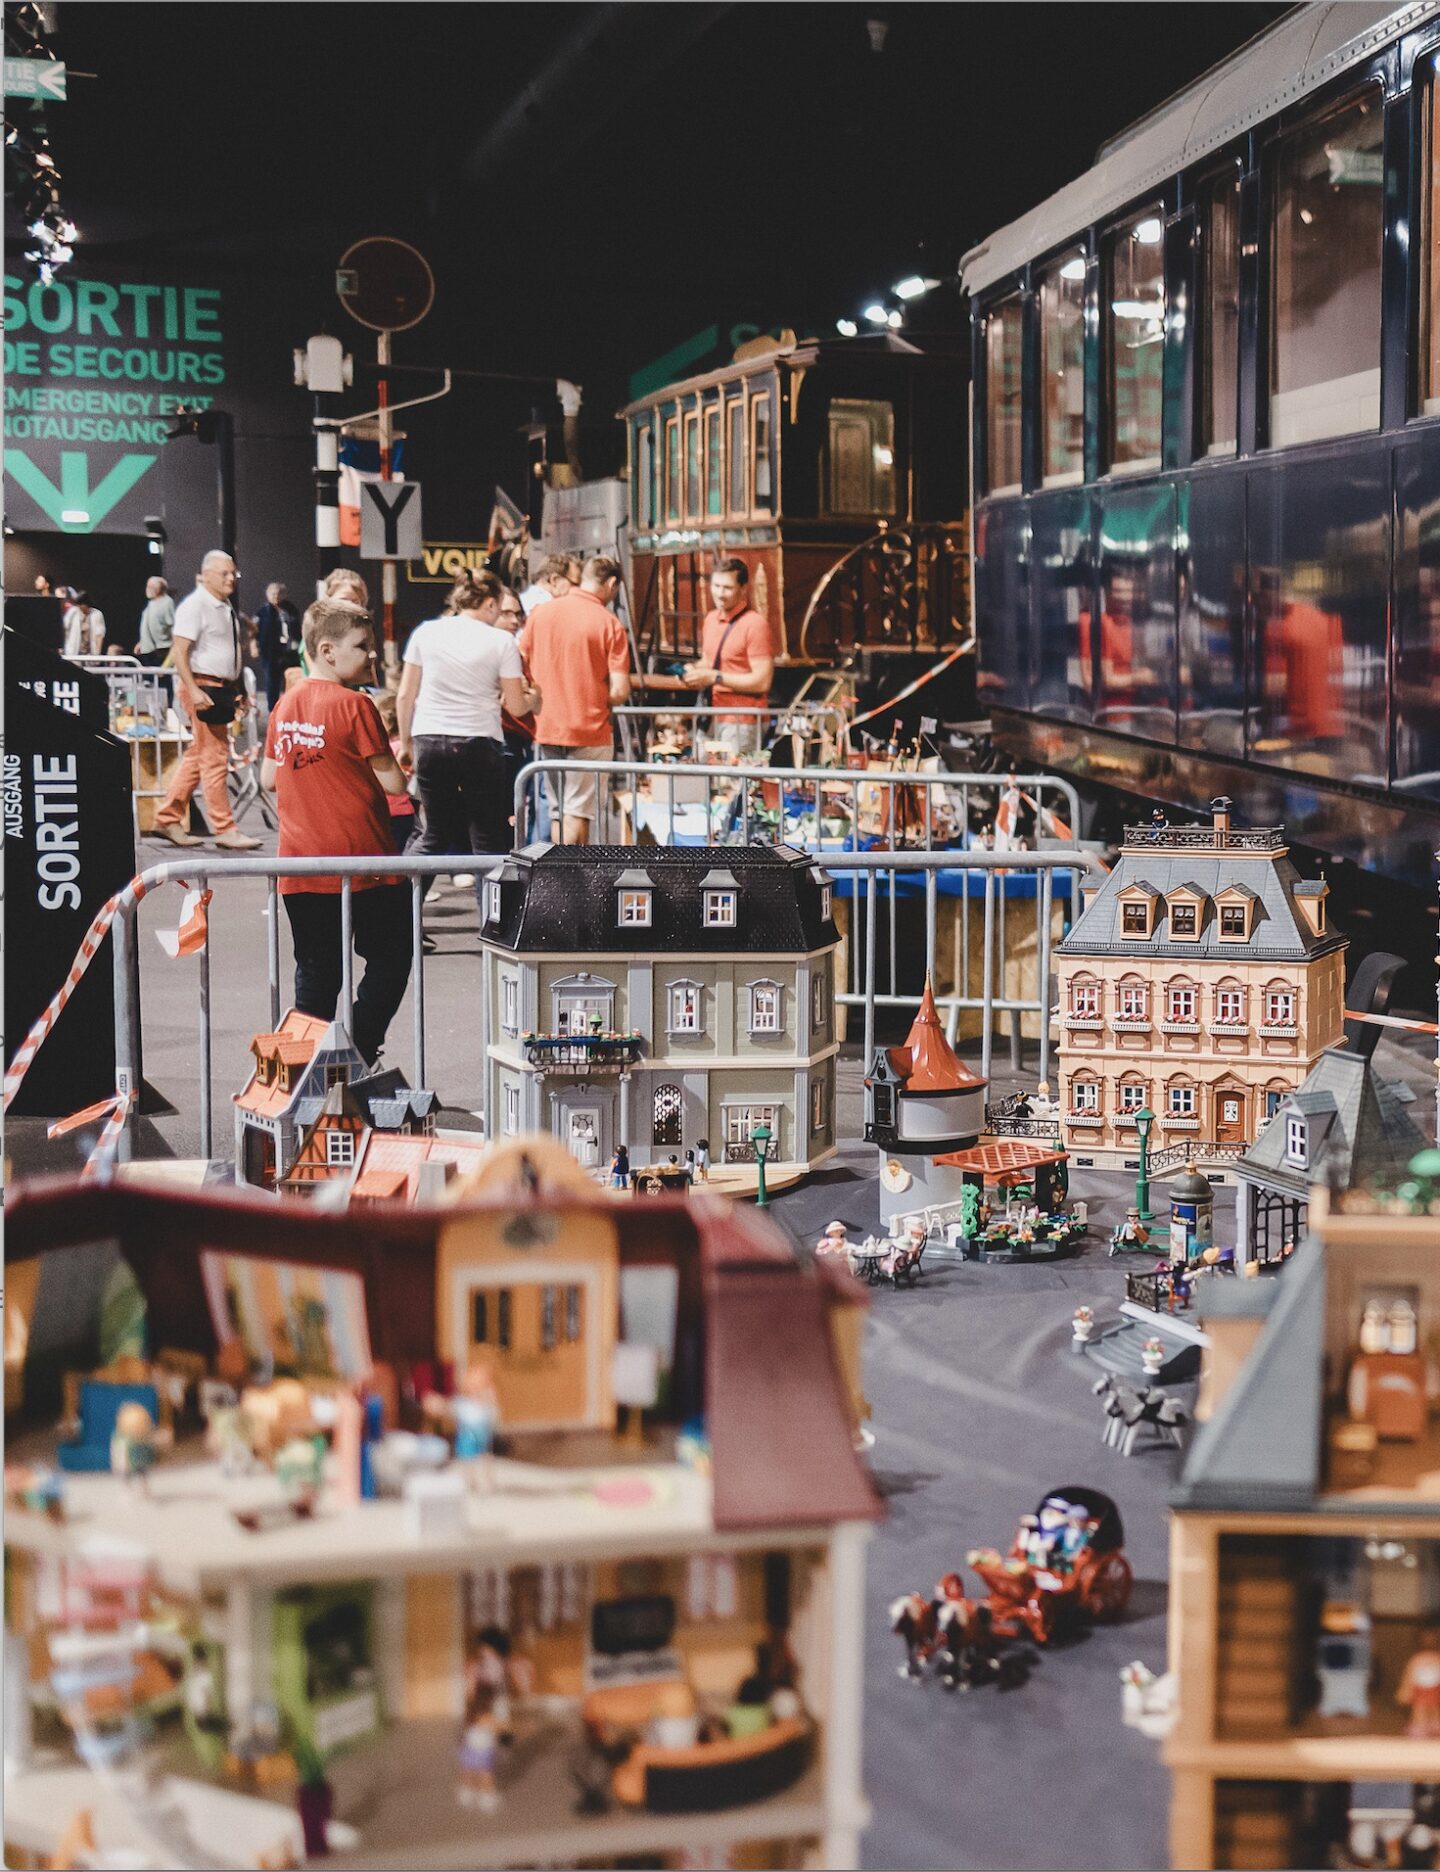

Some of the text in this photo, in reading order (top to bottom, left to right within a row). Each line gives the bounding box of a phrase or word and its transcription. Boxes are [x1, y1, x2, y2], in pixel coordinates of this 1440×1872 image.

[4, 274, 223, 342] SORTIE
[48, 343, 225, 384] SECOURS
[364, 484, 416, 555] Y
[4, 754, 24, 838] AUSGANG
[33, 754, 82, 911] SORTIE
